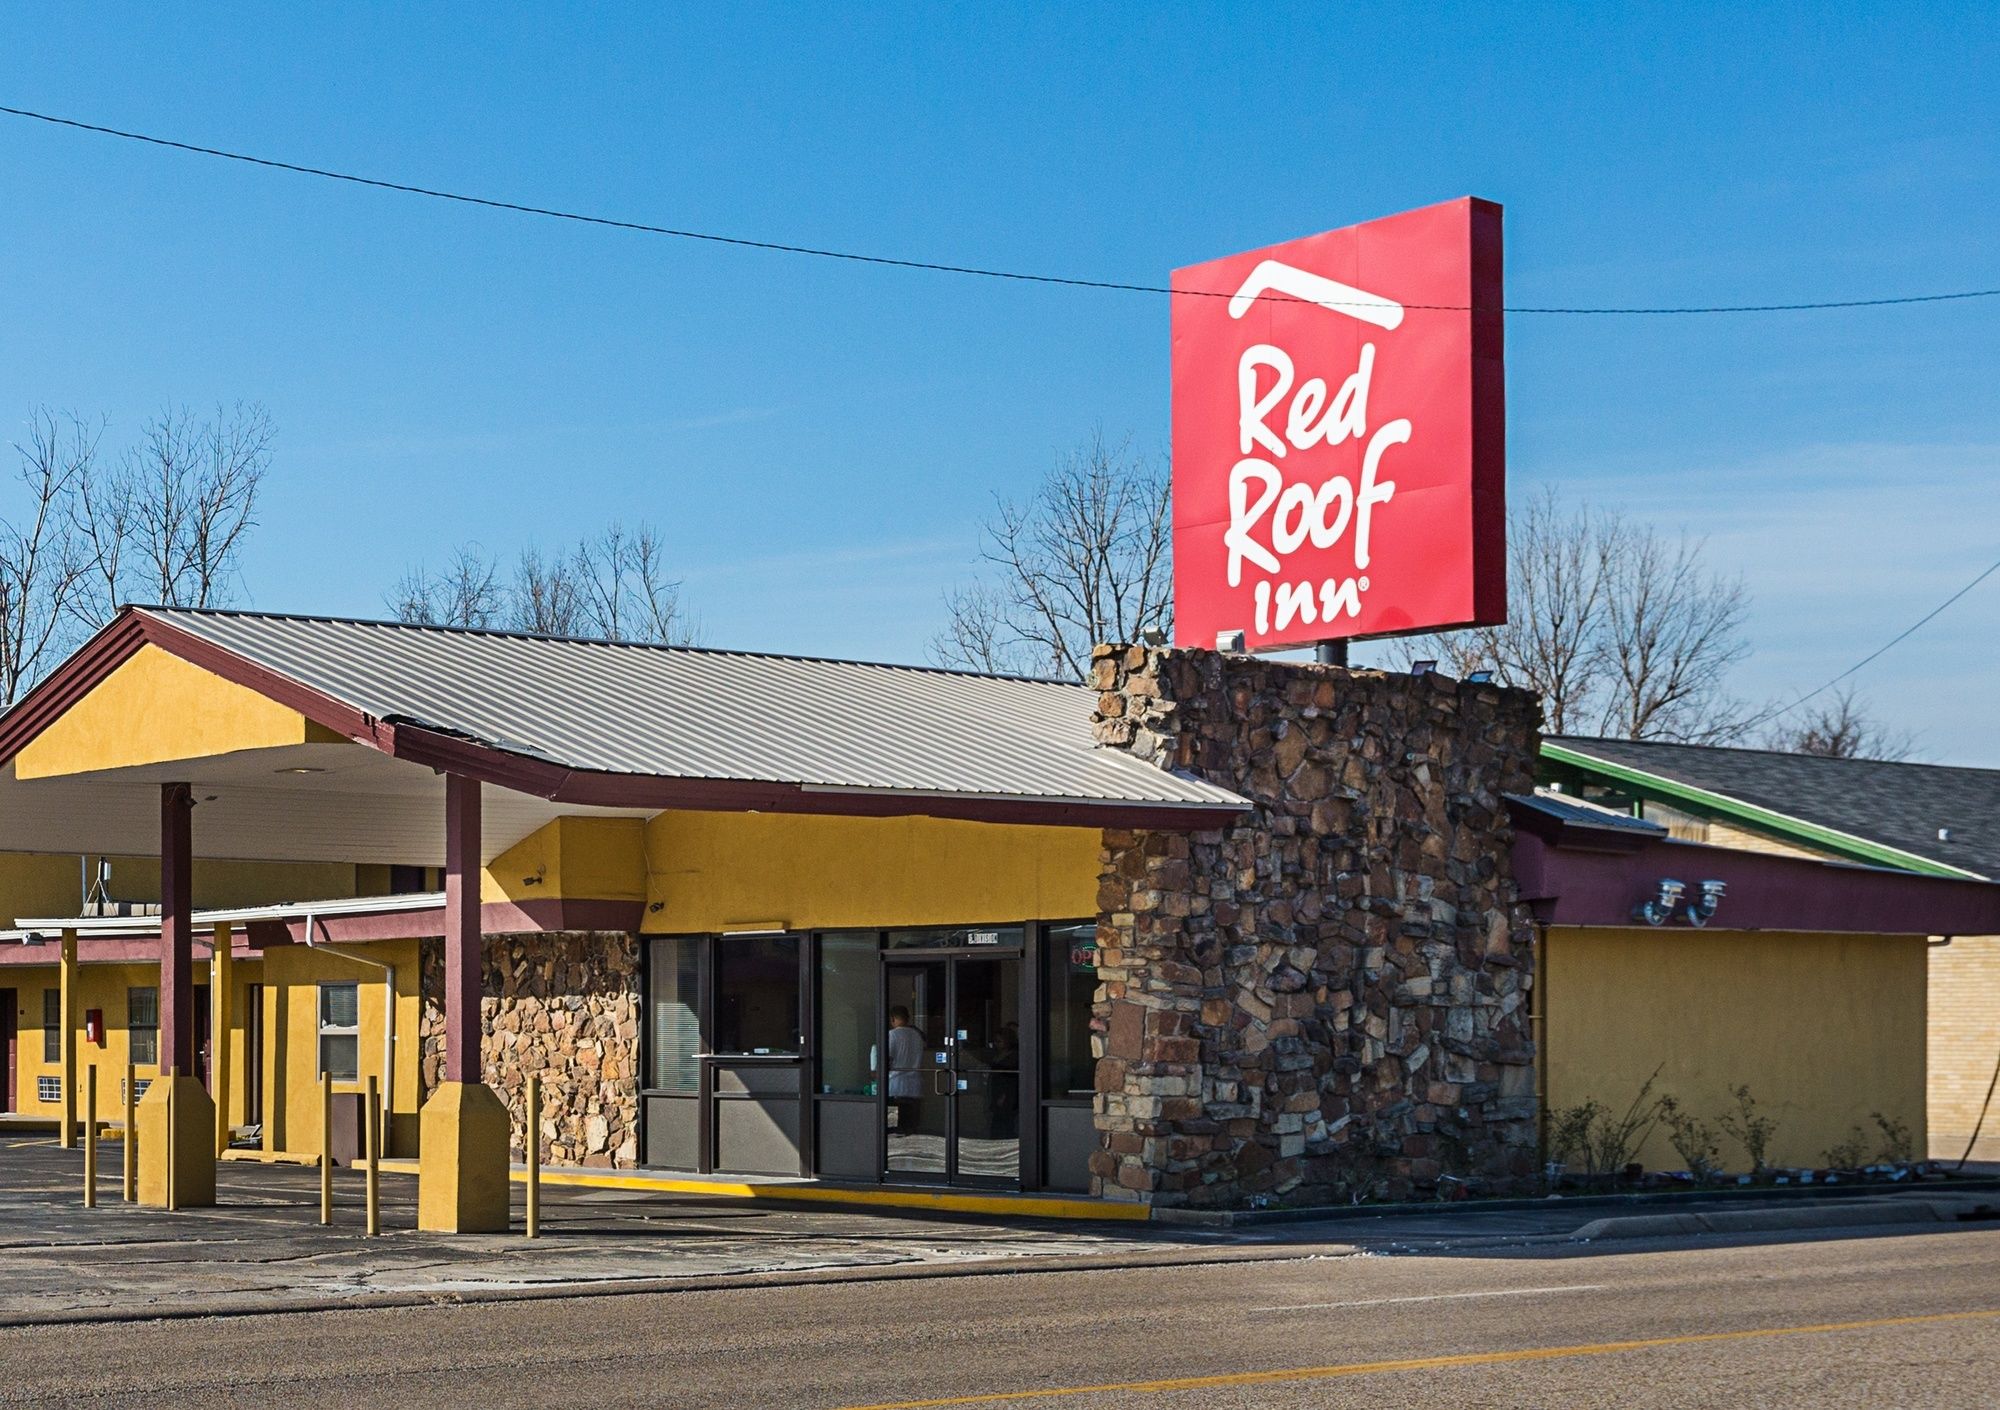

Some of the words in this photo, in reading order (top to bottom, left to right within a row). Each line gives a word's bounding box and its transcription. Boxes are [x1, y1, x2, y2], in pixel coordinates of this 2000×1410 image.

[1238, 342, 1376, 459] Red
[1223, 418, 1412, 588] Roof
[1071, 948, 1093, 964] OP
